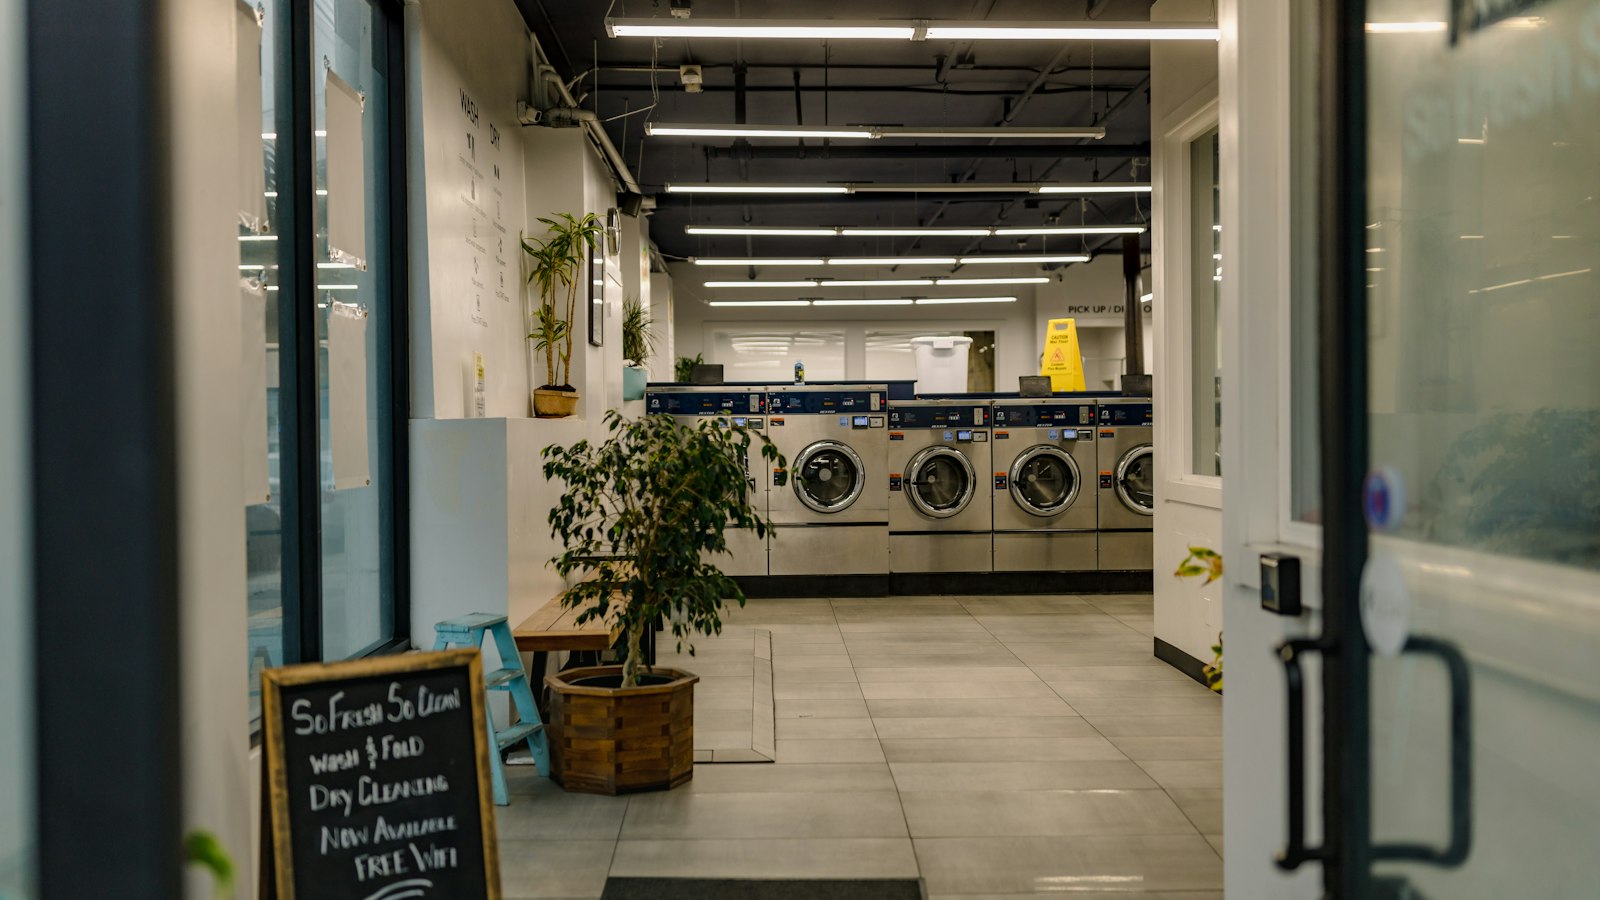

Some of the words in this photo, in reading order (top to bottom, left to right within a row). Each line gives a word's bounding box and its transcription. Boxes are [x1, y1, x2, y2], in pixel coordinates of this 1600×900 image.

[459, 87, 479, 129] WASH
[489, 121, 500, 152] DRY
[1068, 305, 1090, 313] PICK
[1093, 305, 1106, 313] UP
[354, 849, 409, 882] FREE
